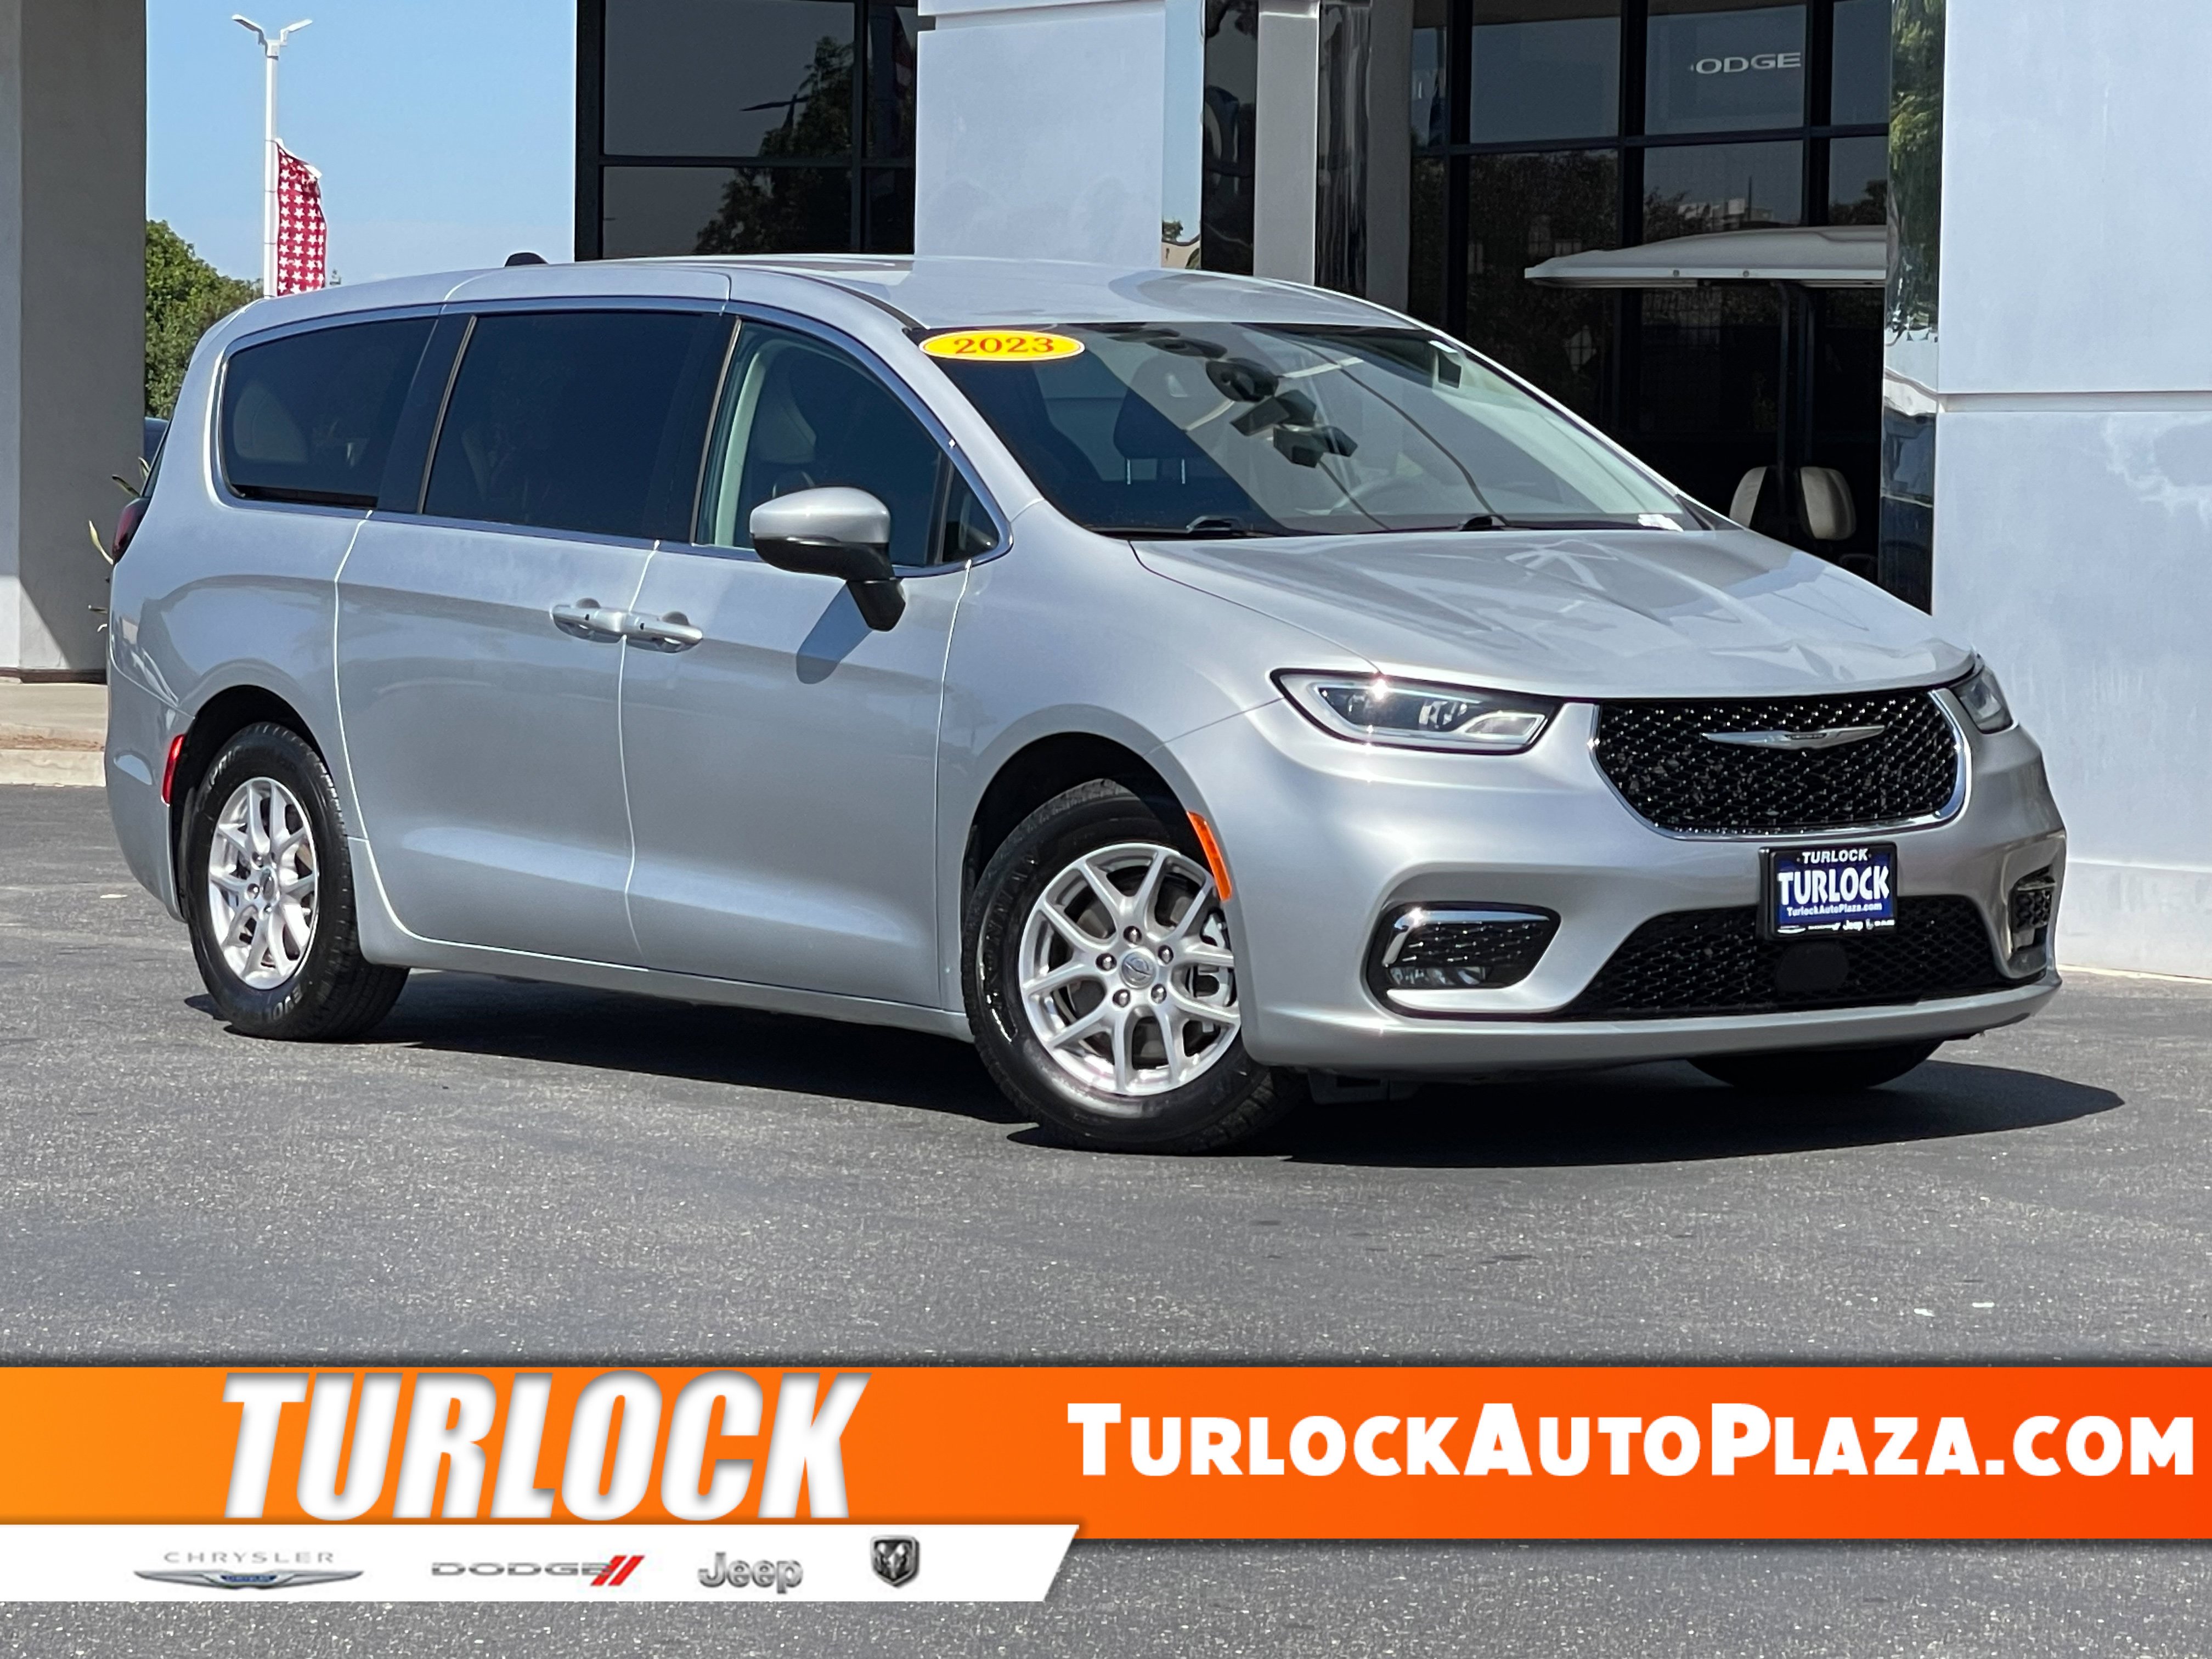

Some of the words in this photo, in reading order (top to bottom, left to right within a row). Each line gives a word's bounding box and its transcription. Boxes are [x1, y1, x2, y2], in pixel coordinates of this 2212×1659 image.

[1689, 52, 1801, 74] ODGE
[953, 337, 1054, 354] 2023
[1802, 848, 1869, 864] TURLOCK
[1778, 865, 1890, 905] TURLOCK
[1786, 902, 1882, 917] TurlockAutoPlaza.com
